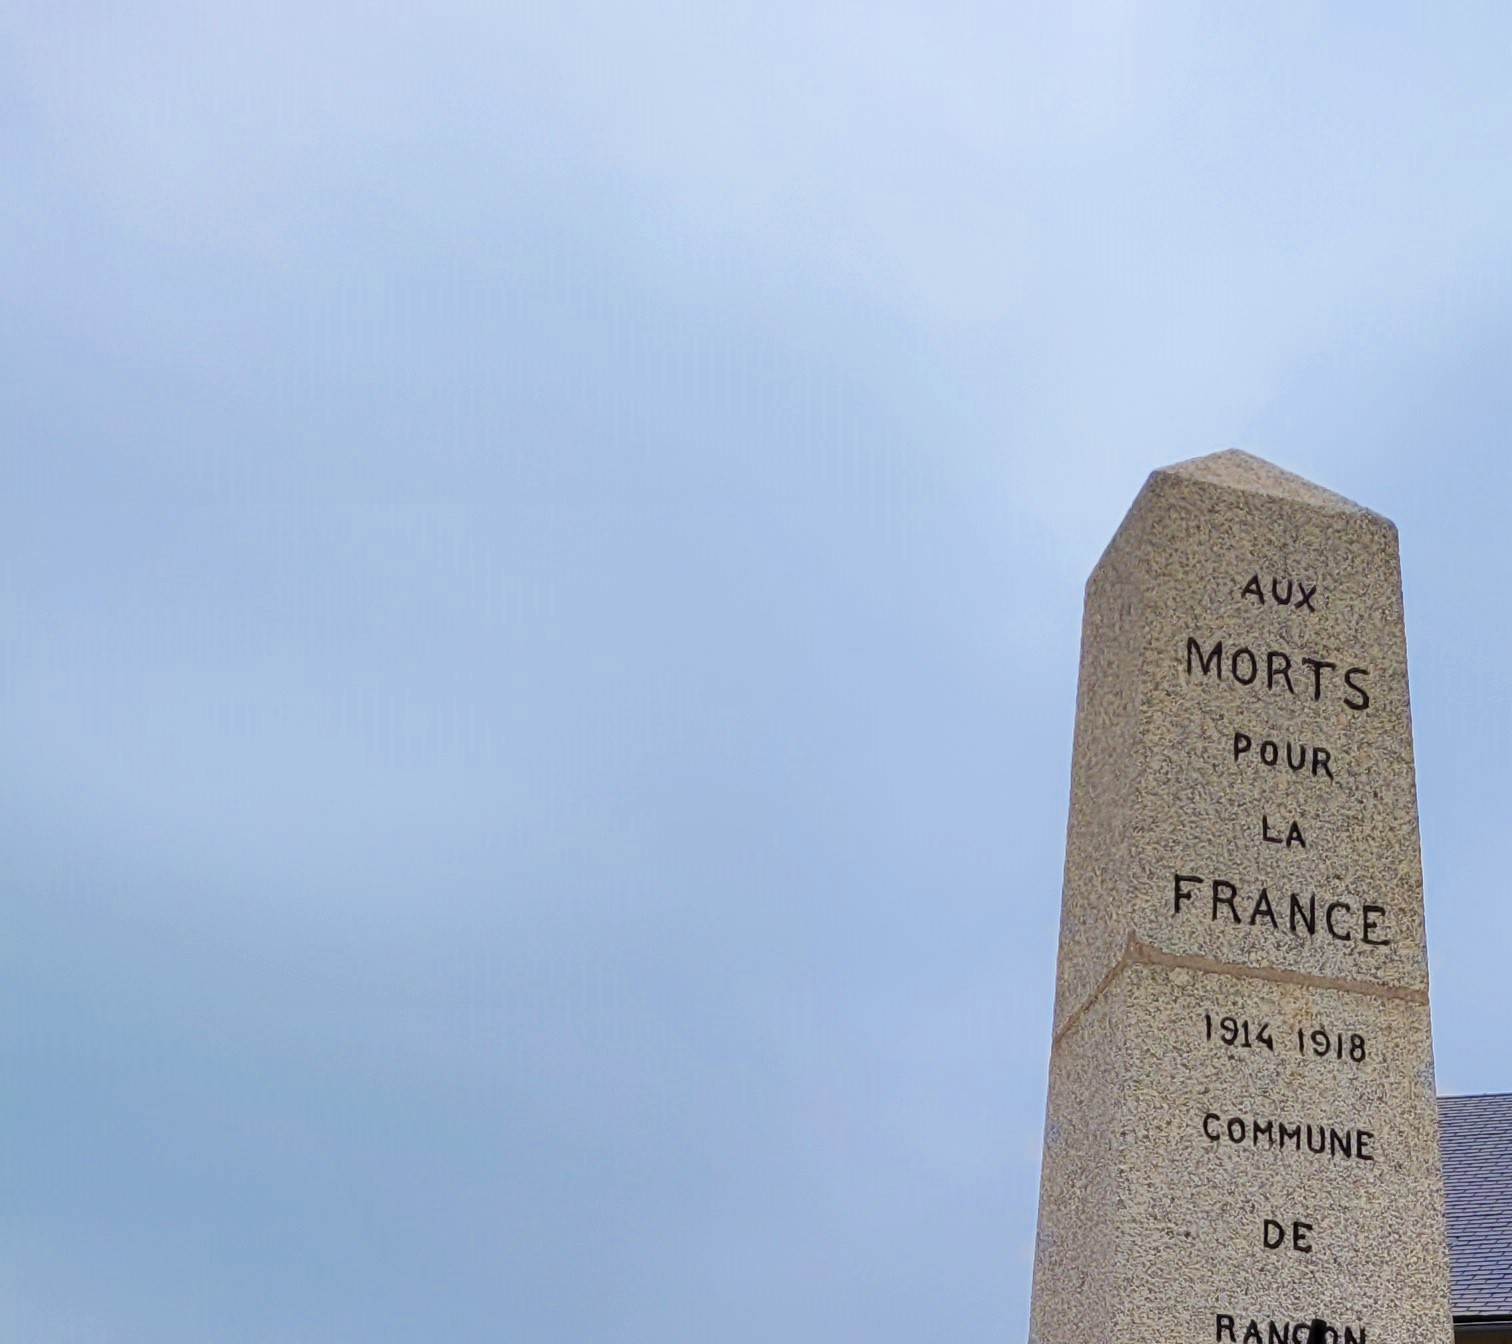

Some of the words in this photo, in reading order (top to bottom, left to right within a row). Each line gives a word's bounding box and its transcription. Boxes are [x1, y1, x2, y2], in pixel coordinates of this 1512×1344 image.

[1240, 574, 1317, 613] AUX
[1186, 636, 1370, 711] MORTS
[1233, 732, 1333, 780] POUR
[1262, 815, 1306, 848] LA
[1174, 874, 1390, 946] FRANCE
[1204, 1014, 1274, 1052] 1914
[1297, 1026, 1366, 1063] 1918
[1202, 1112, 1375, 1161] COMMUNE
[1263, 1218, 1313, 1253] DE
